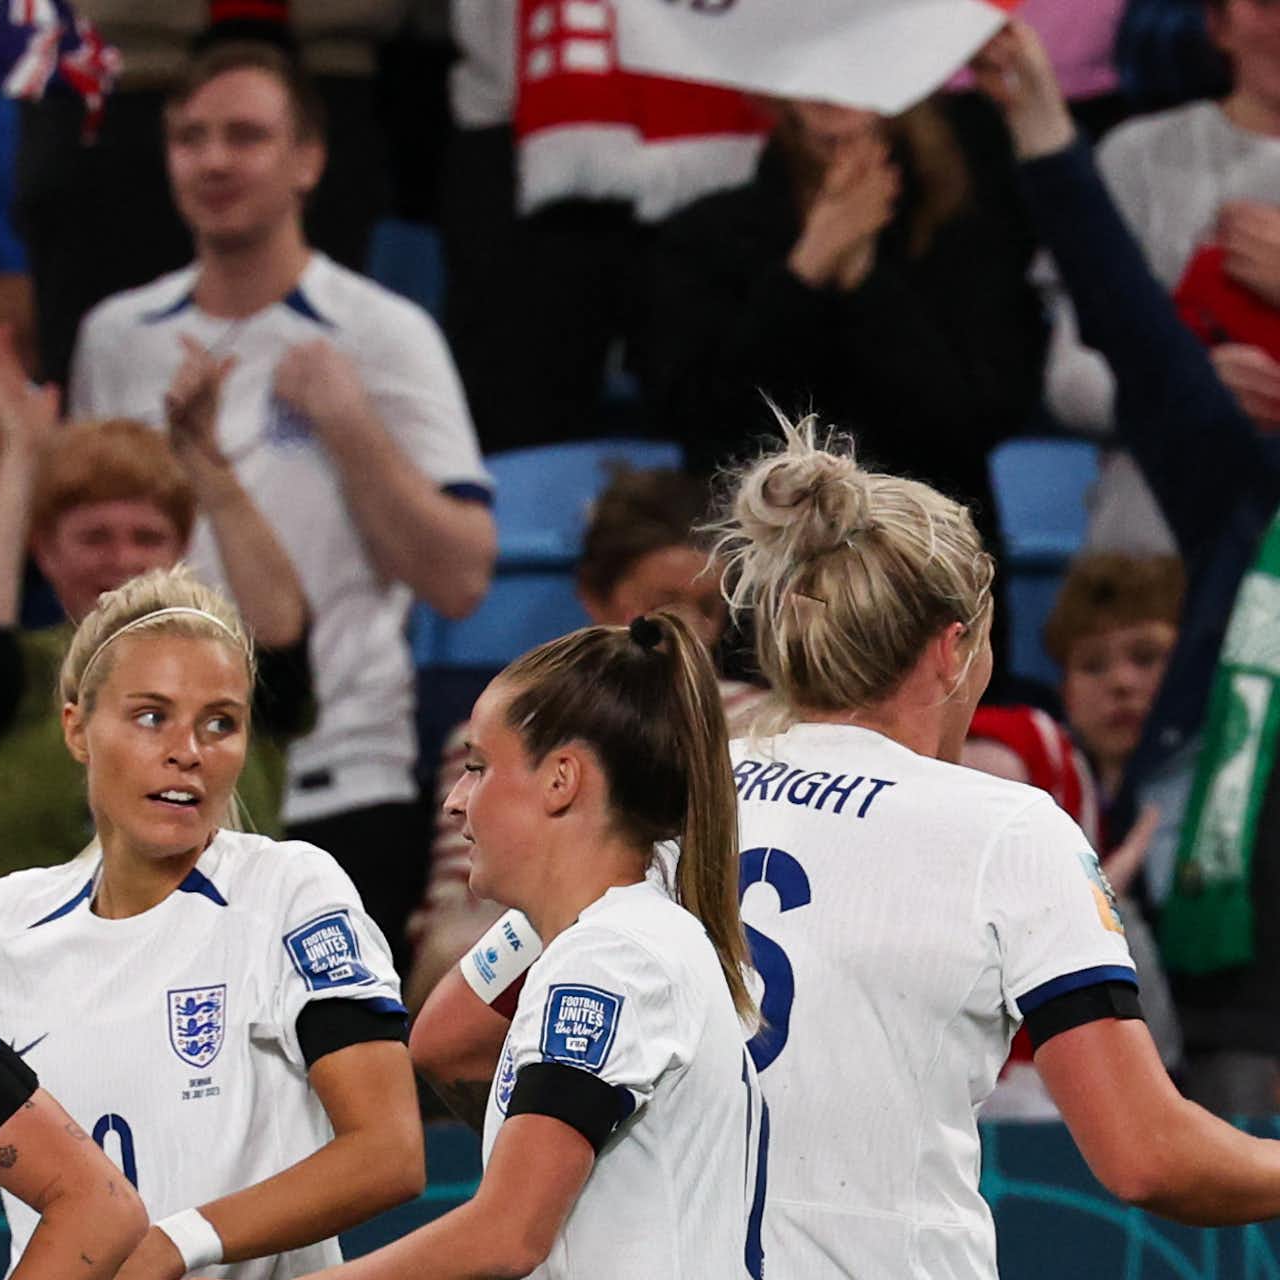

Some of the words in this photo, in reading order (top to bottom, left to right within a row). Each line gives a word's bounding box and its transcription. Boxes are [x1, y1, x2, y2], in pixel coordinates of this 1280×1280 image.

[733, 760, 898, 818] BRIGHT
[301, 925, 343, 949] FOOTBALL
[502, 920, 523, 952] FIFA
[305, 936, 348, 961] UNITES
[558, 1006, 604, 1027] UNITES
[560, 995, 604, 1014] FOOTBALL
[553, 1020, 573, 1034] the
